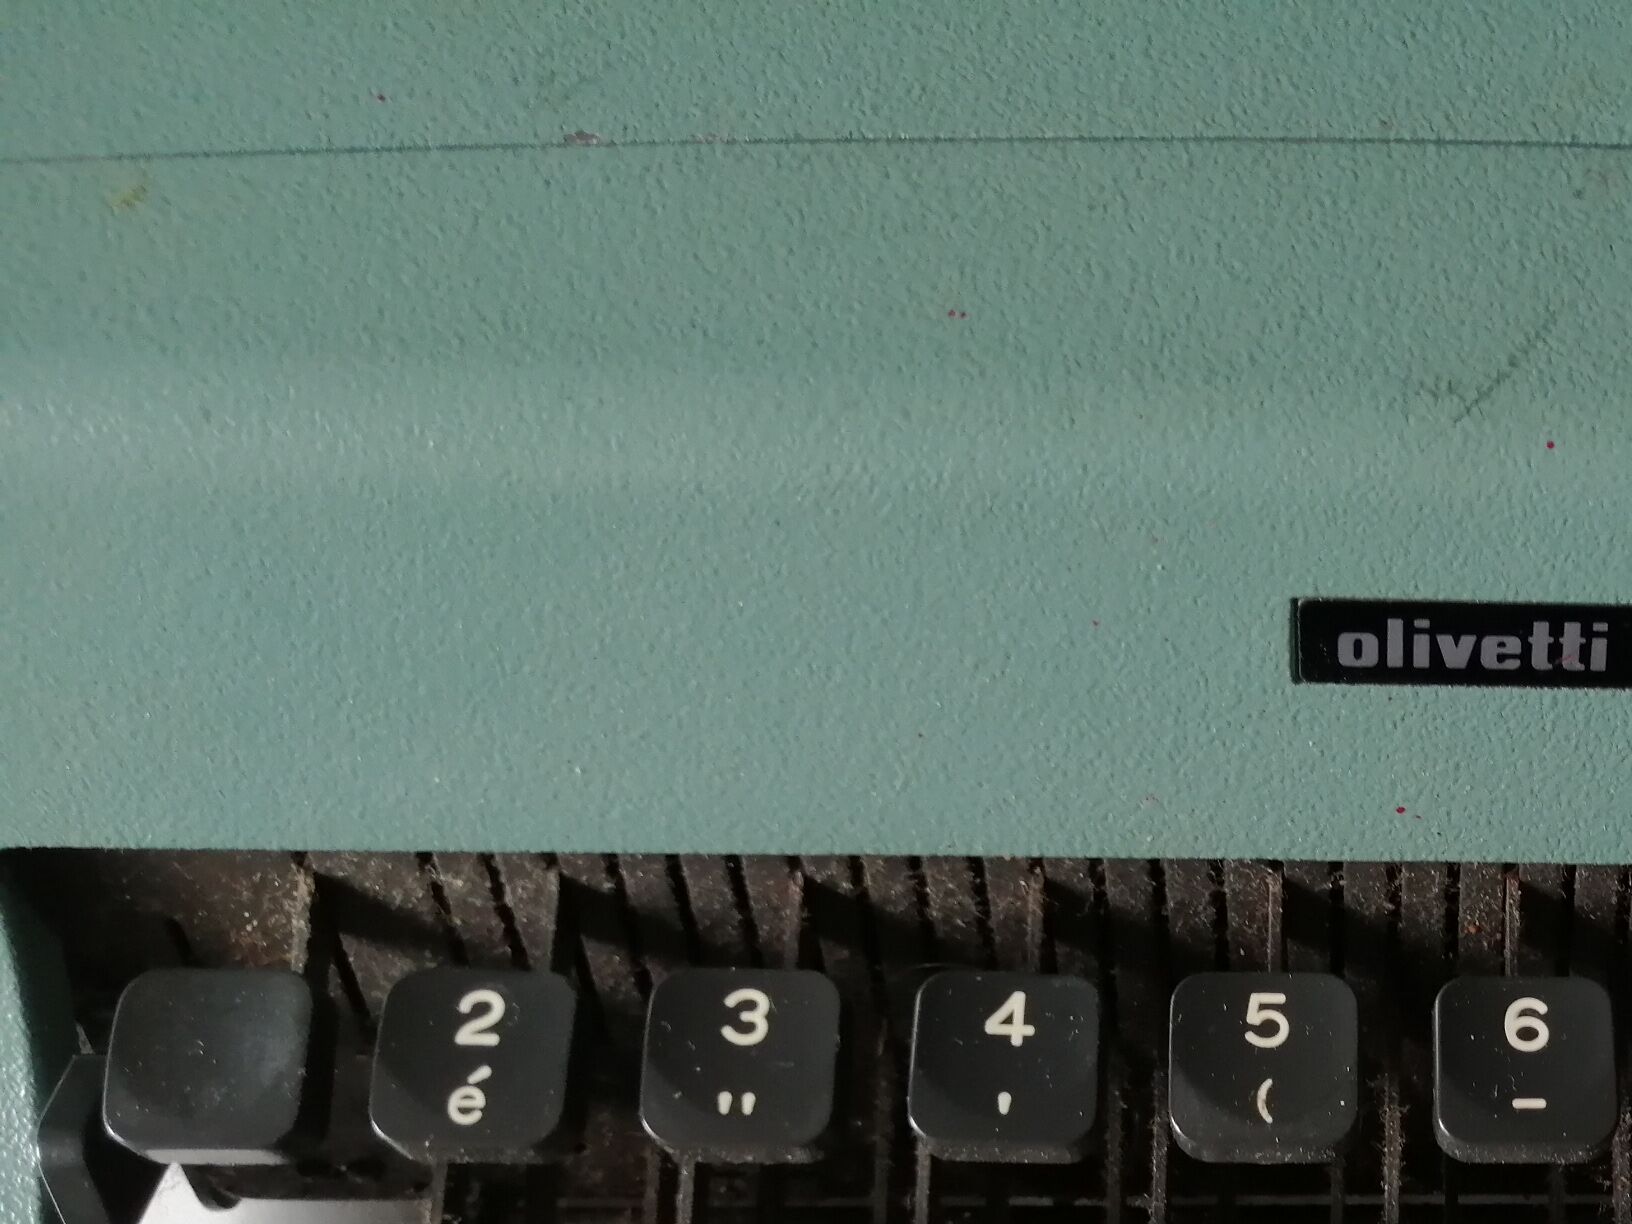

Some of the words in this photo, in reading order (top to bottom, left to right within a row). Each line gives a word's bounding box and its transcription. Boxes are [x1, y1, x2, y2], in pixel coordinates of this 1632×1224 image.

[1337, 619, 1608, 672] olivetti
[454, 988, 506, 1047] 2
[720, 988, 771, 1046] 3
[984, 990, 1036, 1047] 4
[1244, 992, 1290, 1049] 5
[1504, 996, 1550, 1053] 6
[447, 1065, 493, 1126] é
